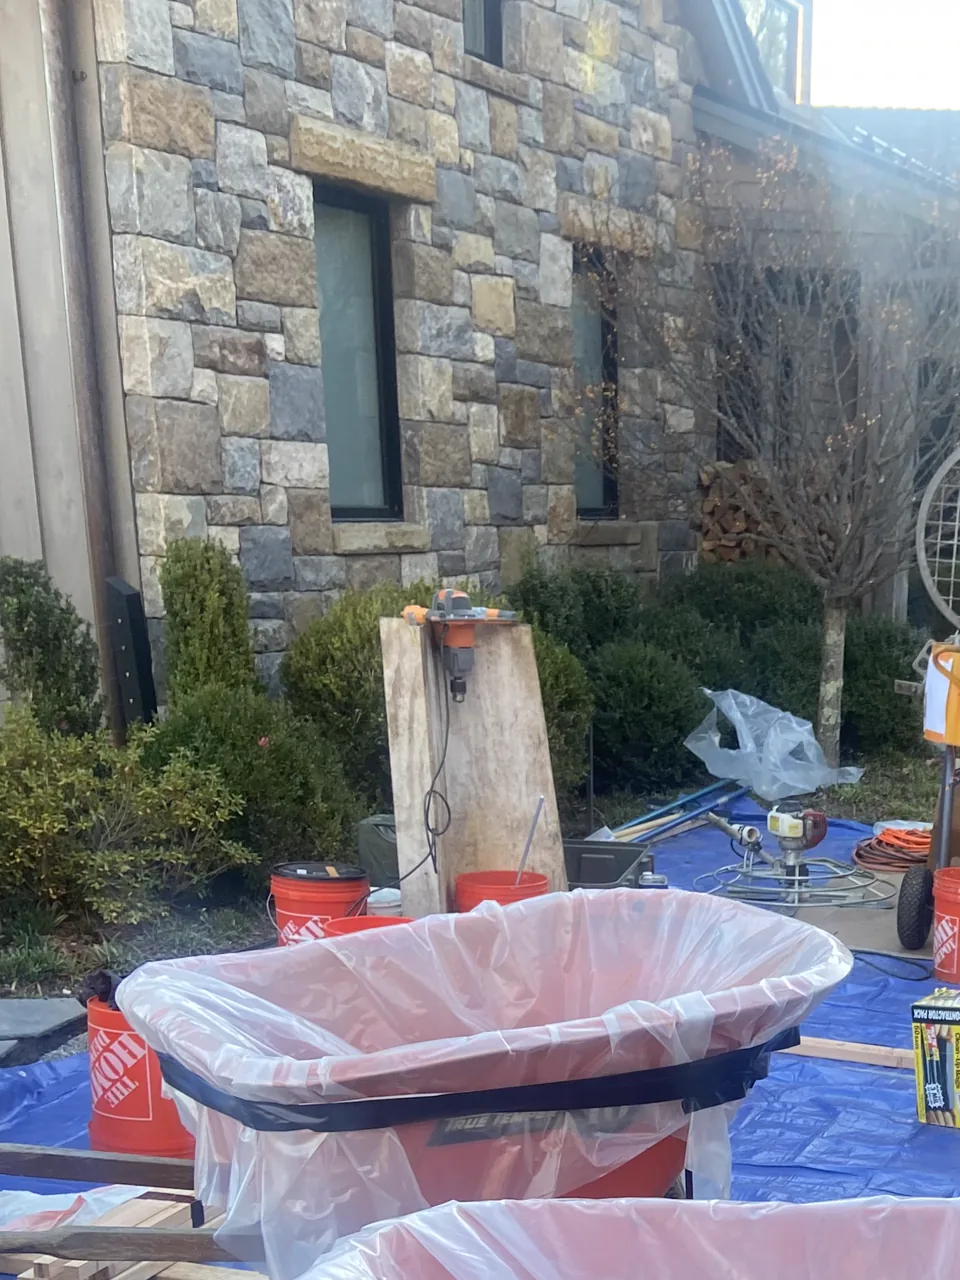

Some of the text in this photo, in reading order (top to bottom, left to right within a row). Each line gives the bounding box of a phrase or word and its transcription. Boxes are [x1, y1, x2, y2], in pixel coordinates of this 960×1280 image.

[913, 1008, 929, 1019] PACK
[104, 1076, 140, 1109] THE
[445, 1116, 490, 1133] TRUE
